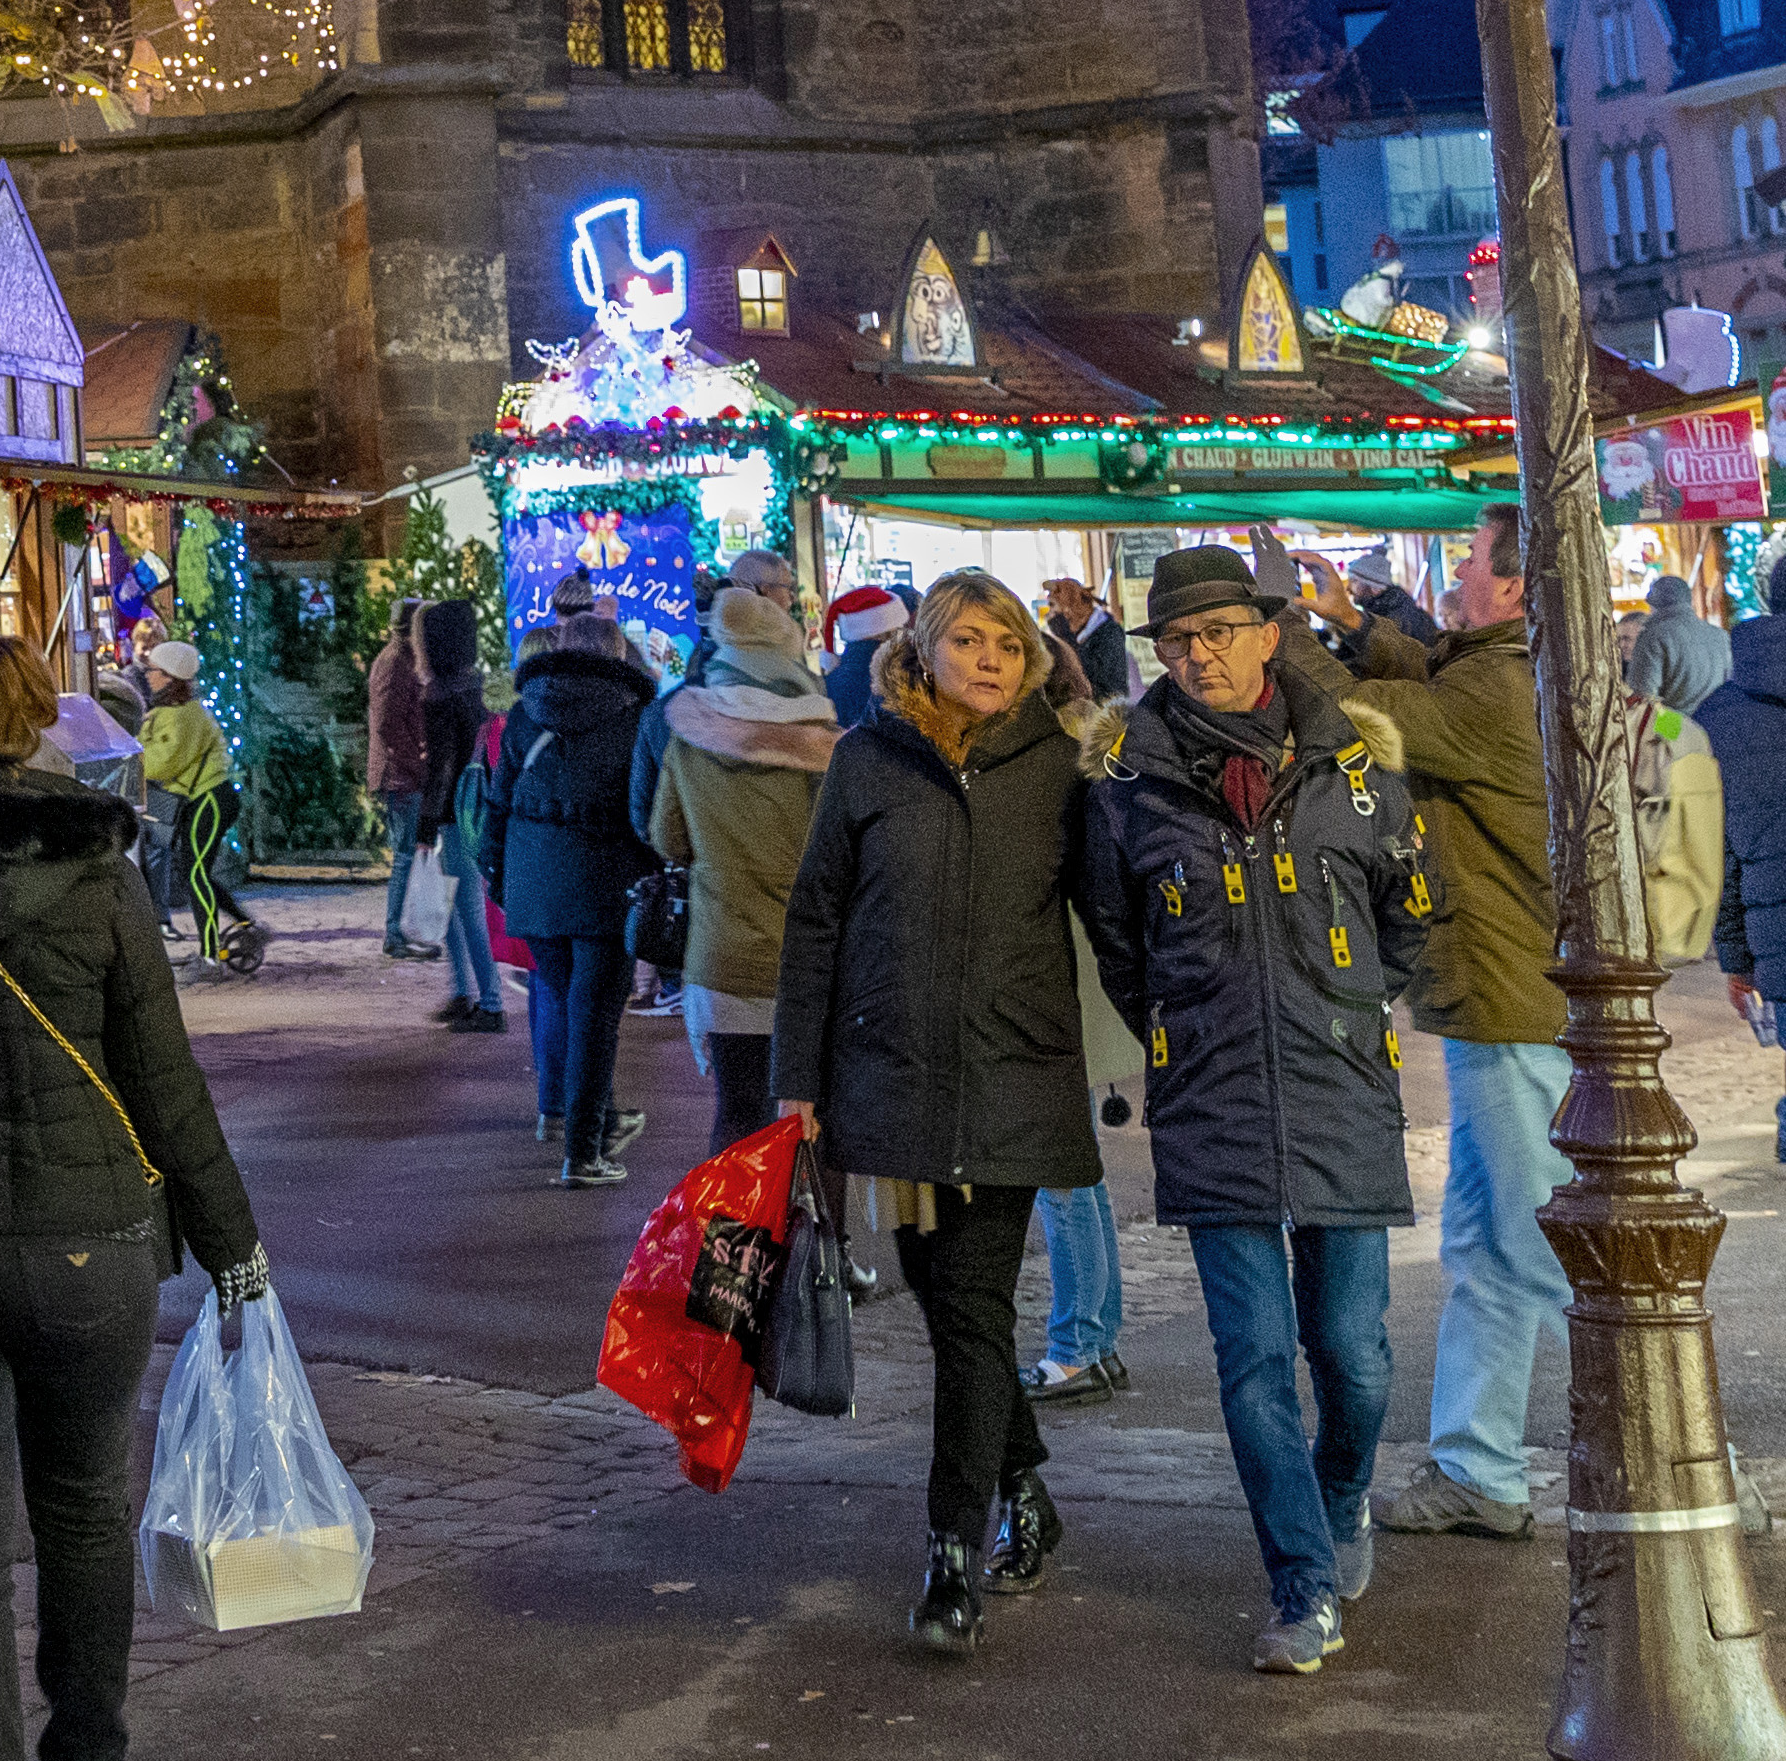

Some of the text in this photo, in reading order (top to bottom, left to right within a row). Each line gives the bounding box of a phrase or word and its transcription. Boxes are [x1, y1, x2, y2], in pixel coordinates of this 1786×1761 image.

[1682, 415, 1737, 453] Vin
[1182, 448, 1237, 469] CHAUD
[1353, 448, 1391, 469] VINO
[1664, 441, 1759, 488] Chaud
